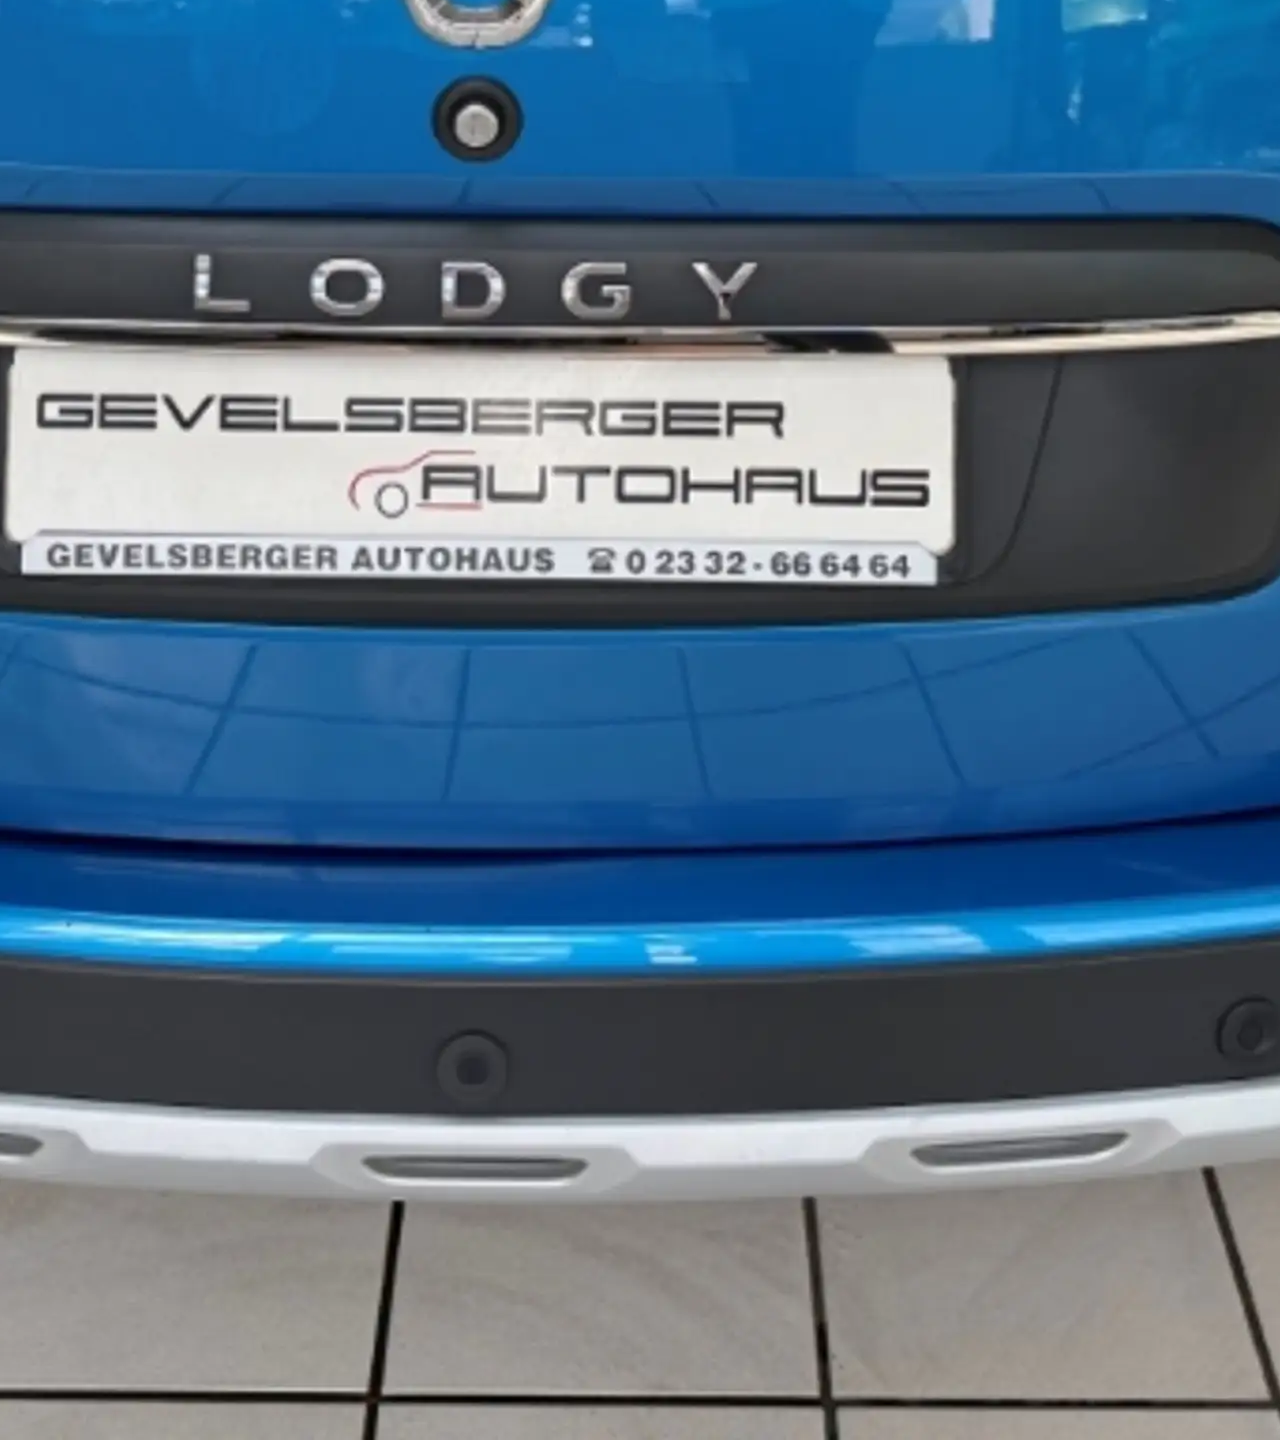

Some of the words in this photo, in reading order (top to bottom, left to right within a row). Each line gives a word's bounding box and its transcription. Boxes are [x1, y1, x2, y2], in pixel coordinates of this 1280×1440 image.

[192, 253, 759, 320] LODGY
[35, 392, 786, 440] GEVELSBERGER
[421, 464, 931, 509] AUTOHAUS
[46, 542, 338, 571] GEVELSBERGER
[350, 546, 556, 574] AUTOHAUS
